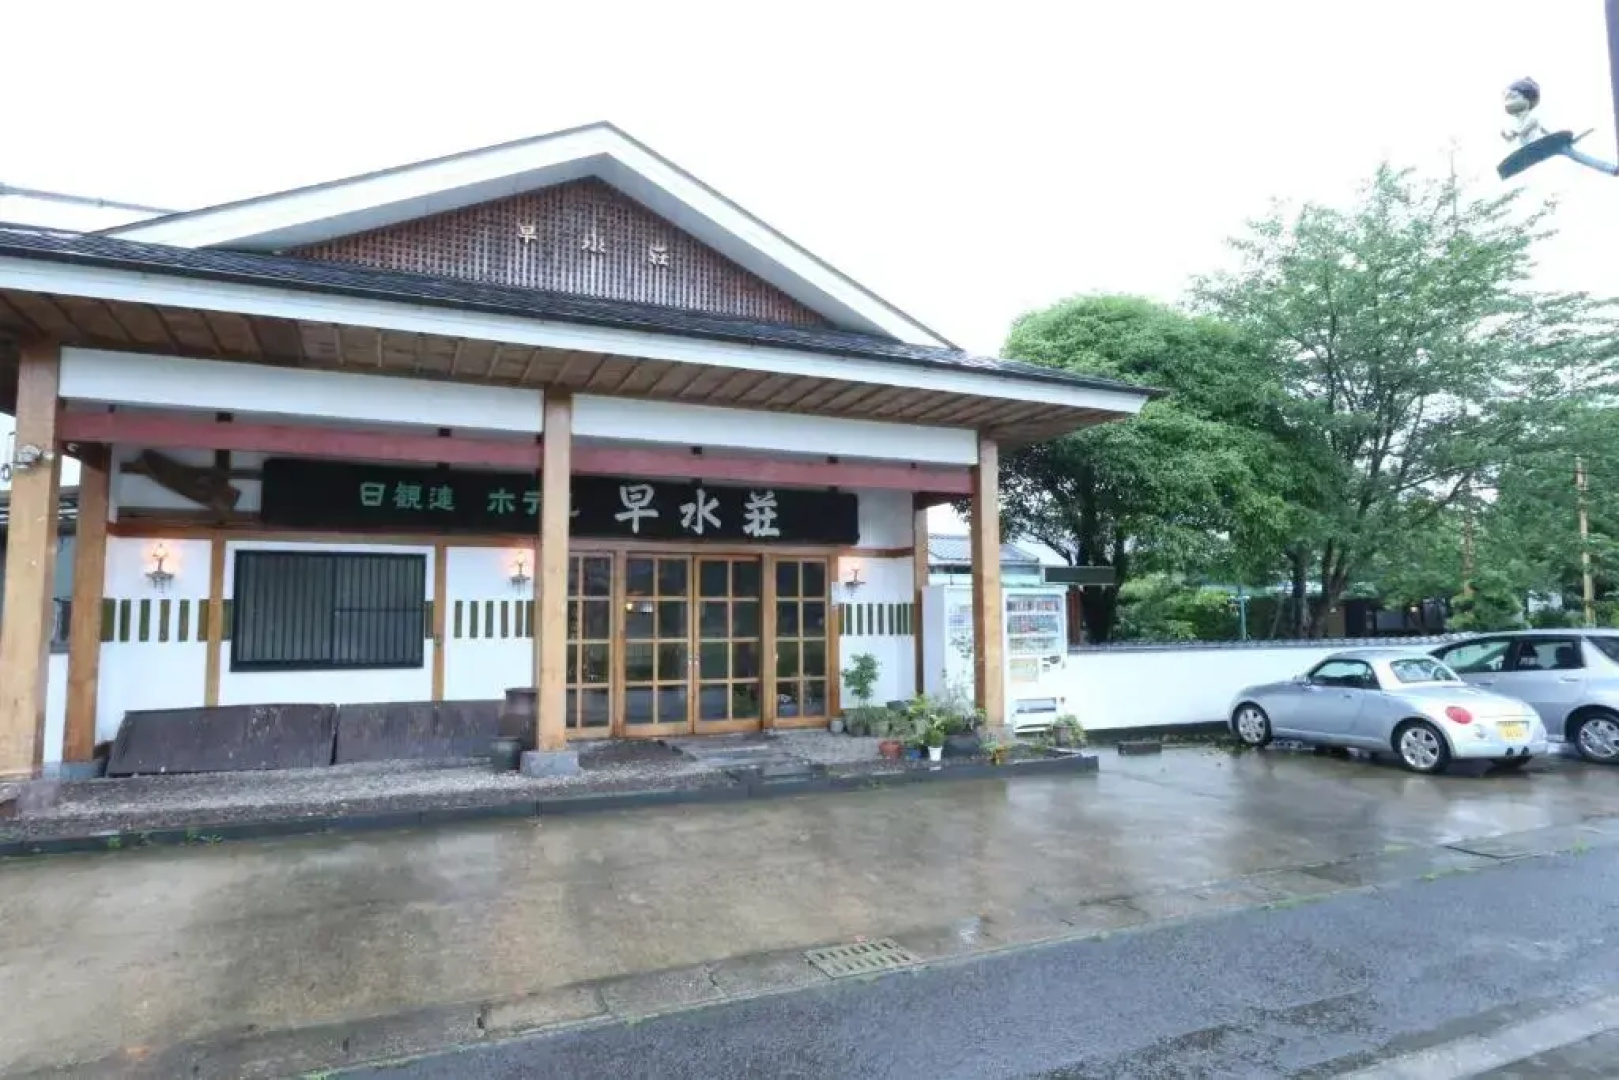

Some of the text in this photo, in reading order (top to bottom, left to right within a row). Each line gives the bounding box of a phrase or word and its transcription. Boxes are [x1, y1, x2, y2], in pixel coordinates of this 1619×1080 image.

[487, 487, 581, 518] ホテ
[614, 483, 781, 537] 早水荘
